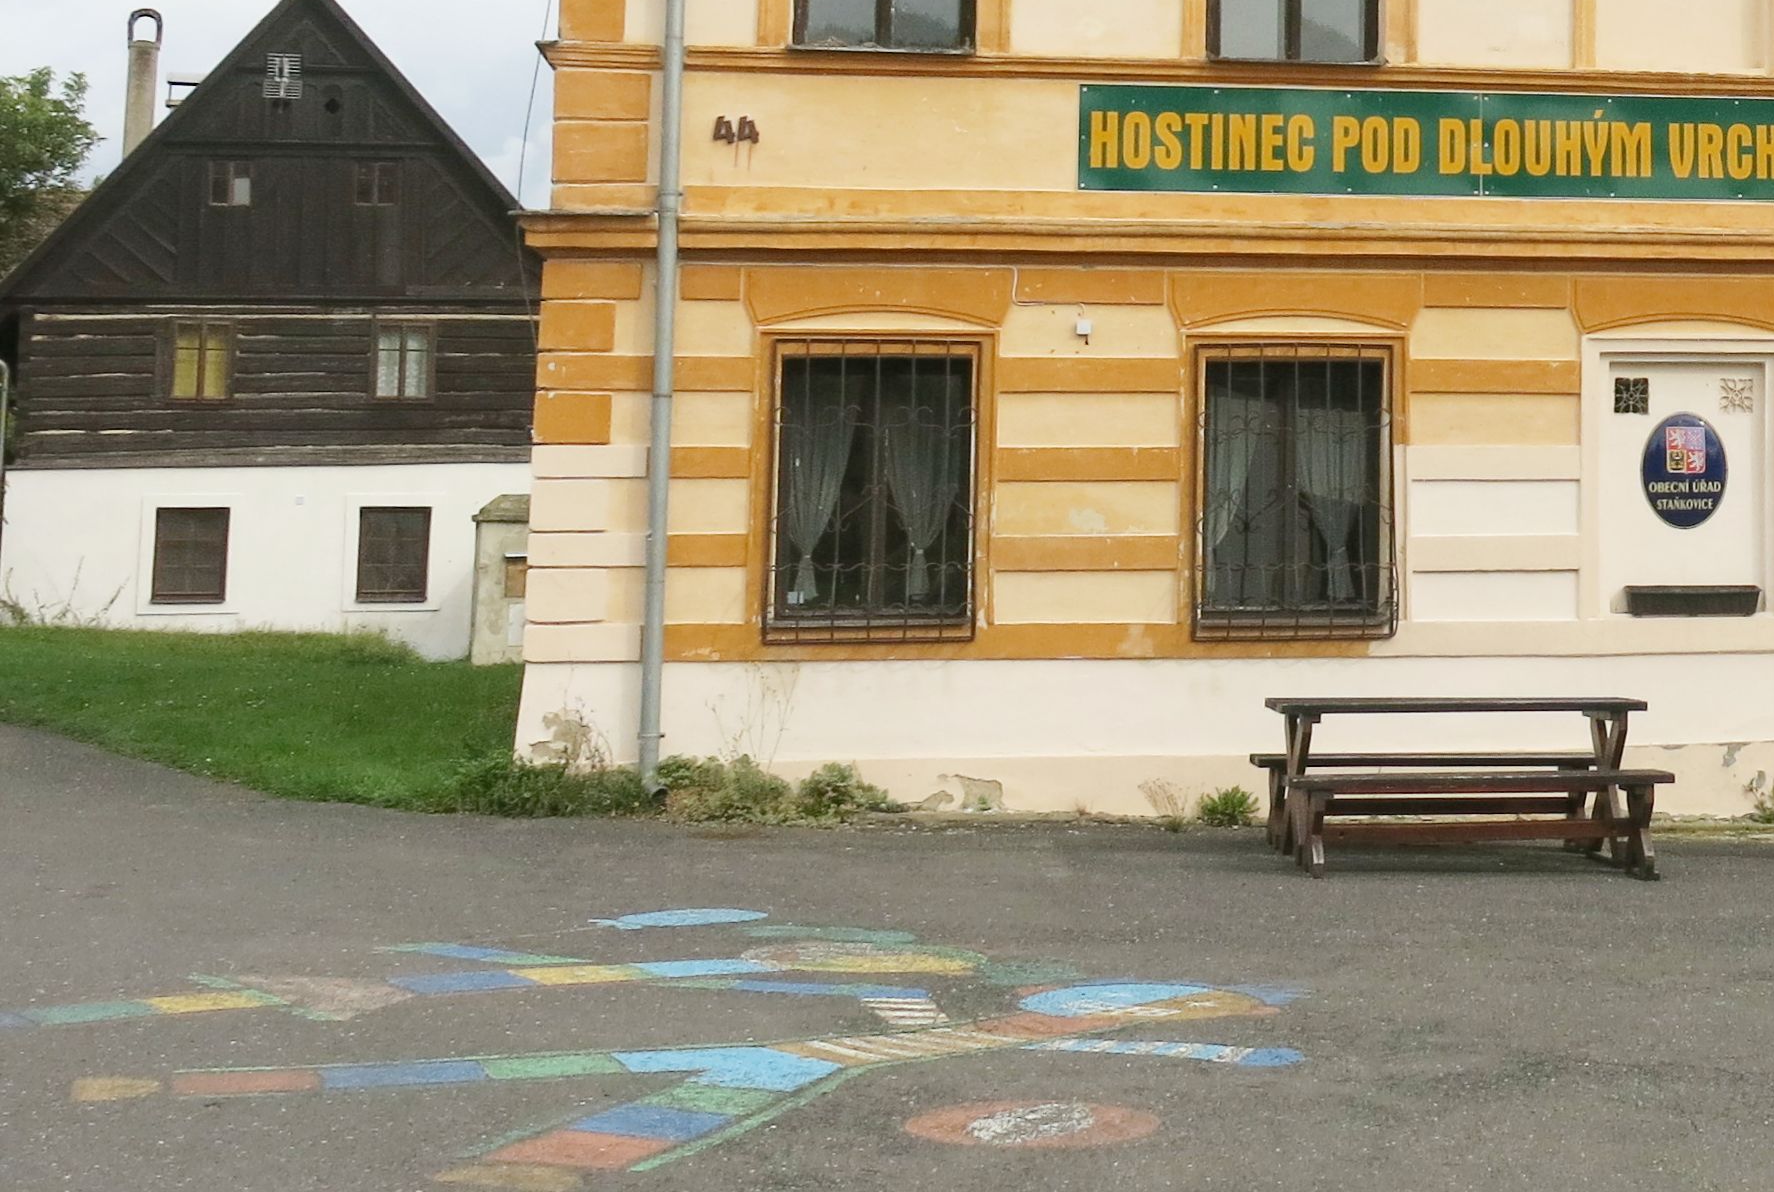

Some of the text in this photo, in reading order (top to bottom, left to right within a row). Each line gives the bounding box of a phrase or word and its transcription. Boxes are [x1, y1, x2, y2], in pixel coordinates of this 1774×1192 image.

[713, 115, 760, 145] 44
[1089, 110, 1315, 172] HOSTINEC
[1332, 115, 1421, 174] POD
[1438, 109, 1652, 178] DLOUHÝM
[1649, 479, 1721, 493] OBECNÍ ÚŘAD
[1657, 496, 1713, 510] STAŇKOVICE
